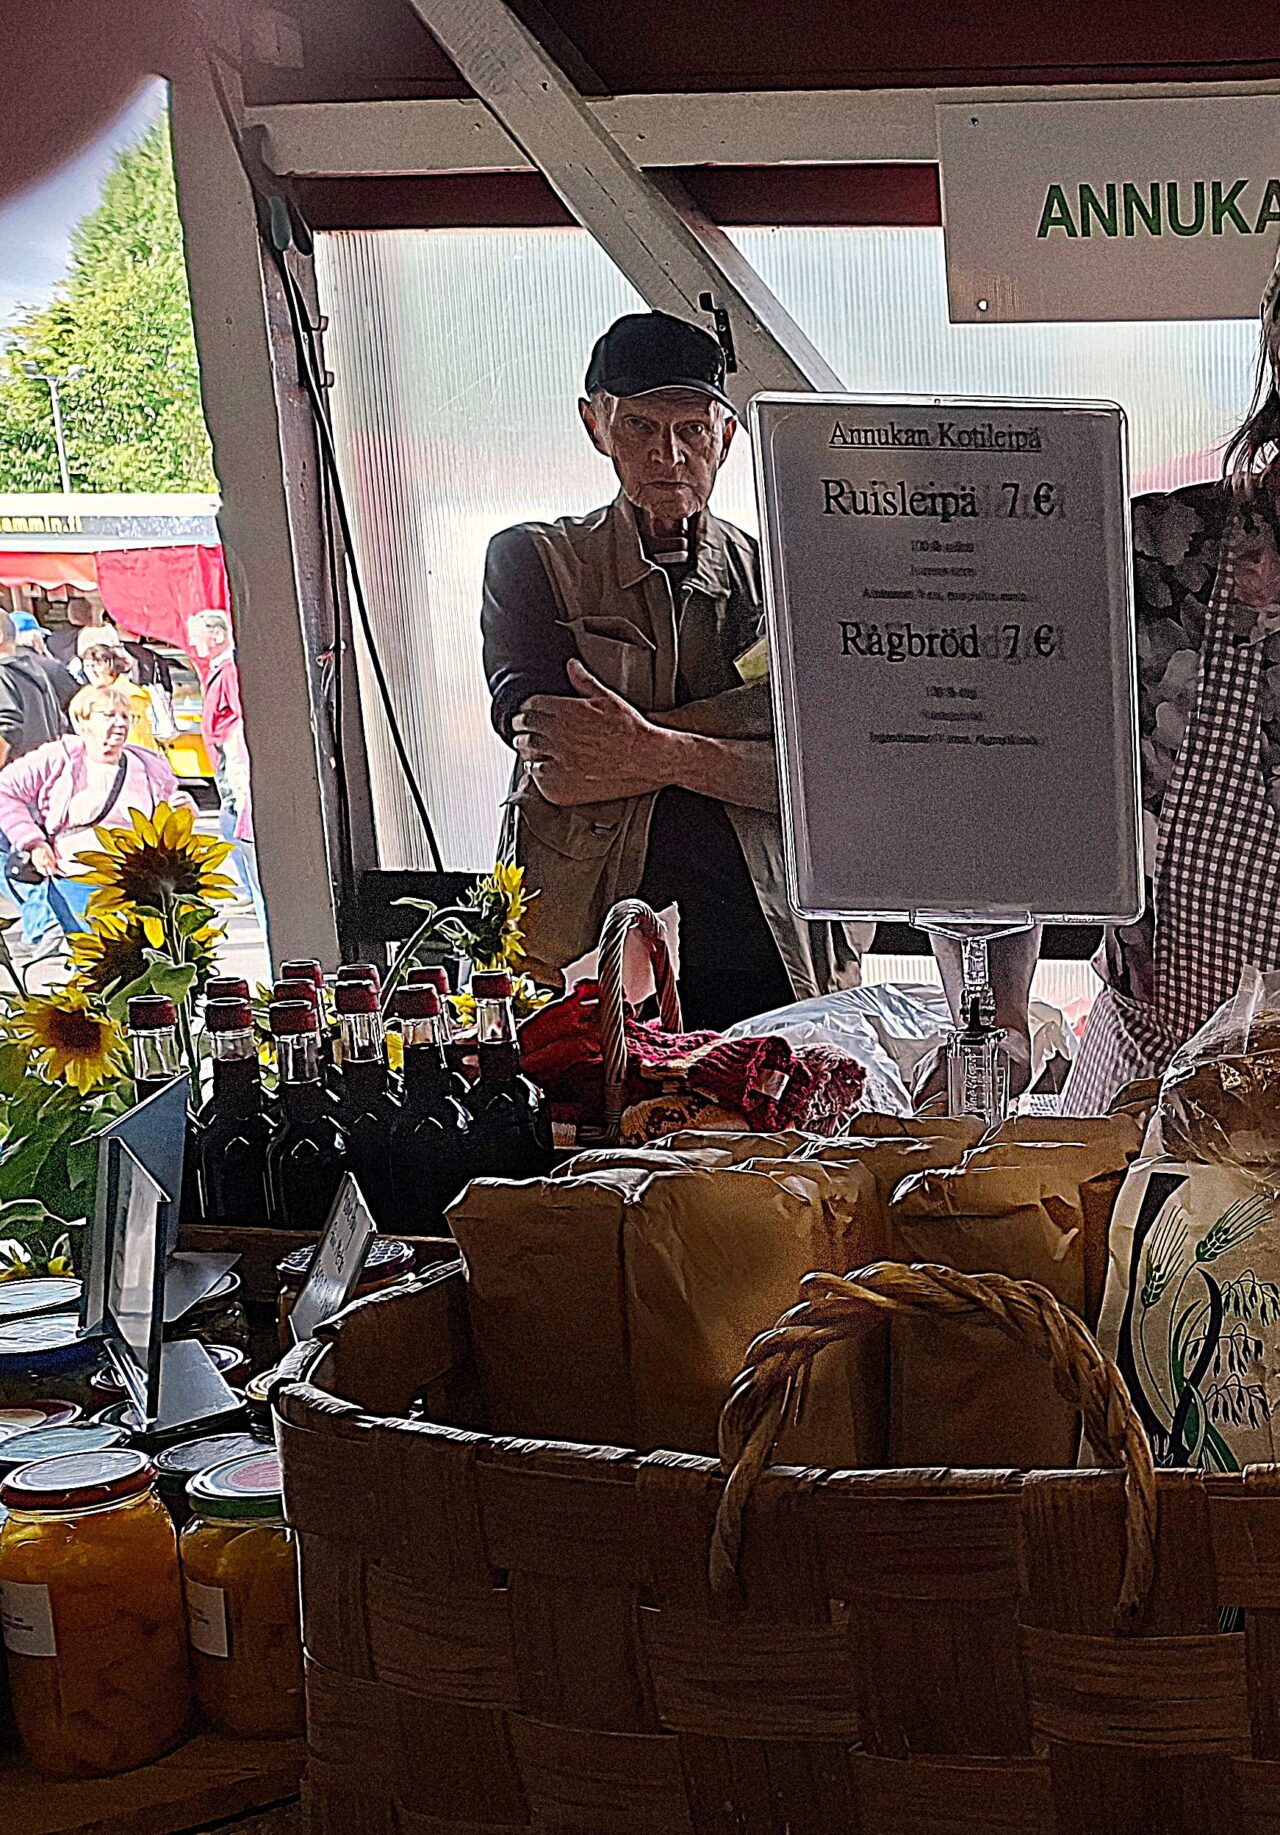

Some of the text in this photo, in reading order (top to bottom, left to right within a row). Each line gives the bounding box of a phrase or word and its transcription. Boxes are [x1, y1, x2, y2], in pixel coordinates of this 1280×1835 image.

[829, 421, 1042, 450] Annukan Kotileipä
[820, 479, 1056, 523] Ruisleipä 7 €
[838, 621, 1056, 662] Rågbröd 7 €
